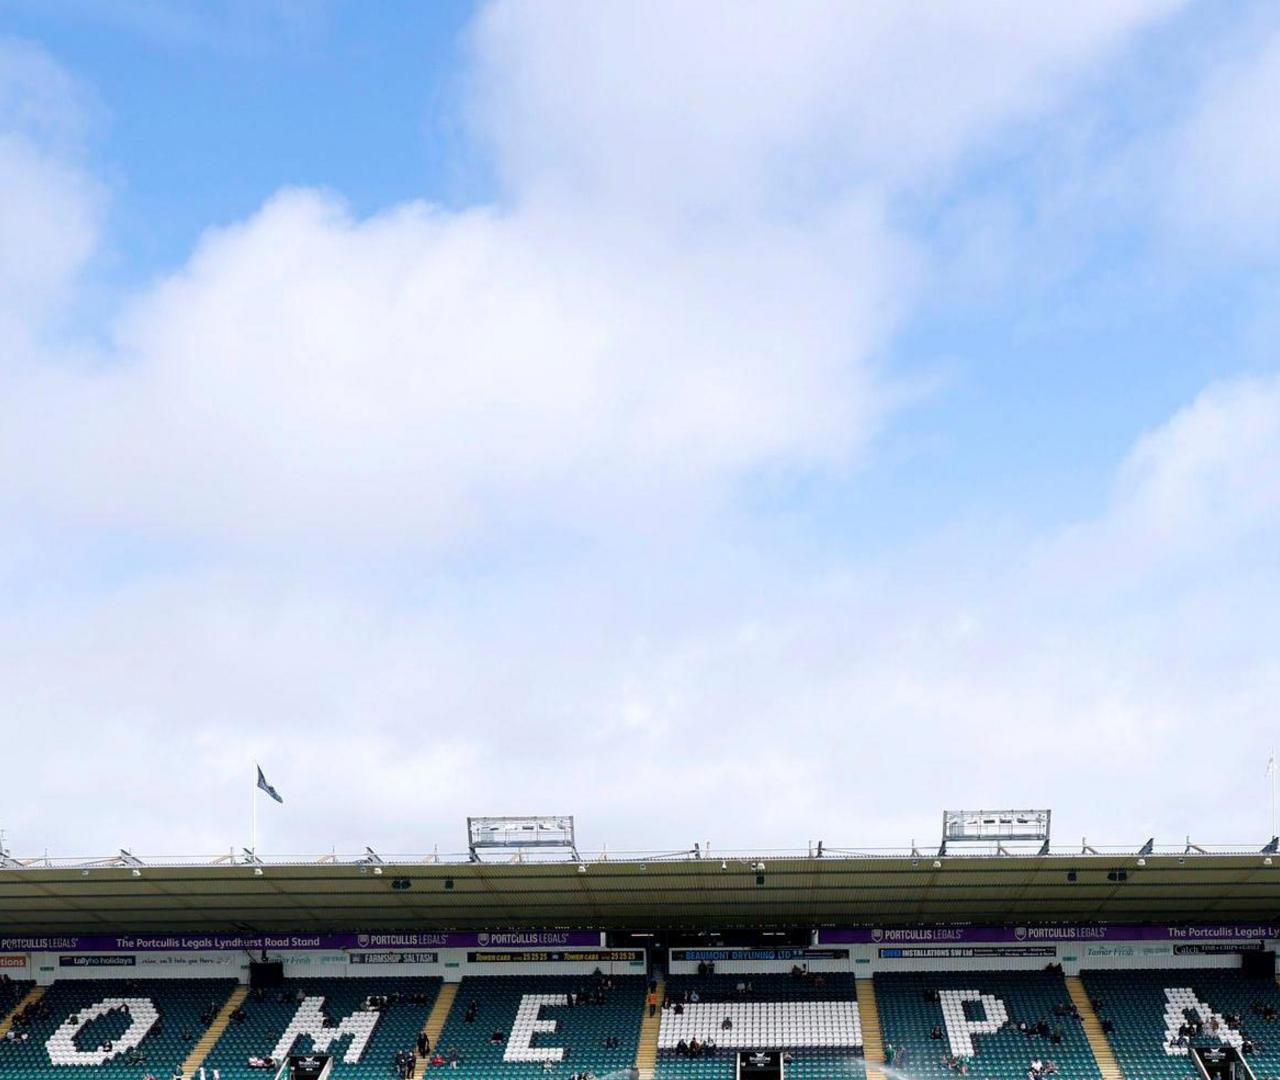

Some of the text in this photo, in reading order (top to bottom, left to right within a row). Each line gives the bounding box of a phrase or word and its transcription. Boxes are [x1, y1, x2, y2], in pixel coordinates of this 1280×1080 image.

[885, 929, 961, 940] PORTCULLIS LEGALS
[1028, 927, 1104, 938] PORTCULLIS LEGALS
[1169, 927, 1188, 938] The
[1189, 928, 1233, 938] Portcullis
[1235, 928, 1267, 939] Legals
[0, 937, 75, 949] PORTCULLIS LEGALS
[116, 936, 321, 950] The Portcullis Legals Lyndhurst Road Stand
[370, 934, 445, 945] PORTCULLIS LEGALS
[491, 933, 566, 944] PORTCULLIS LEGALS
